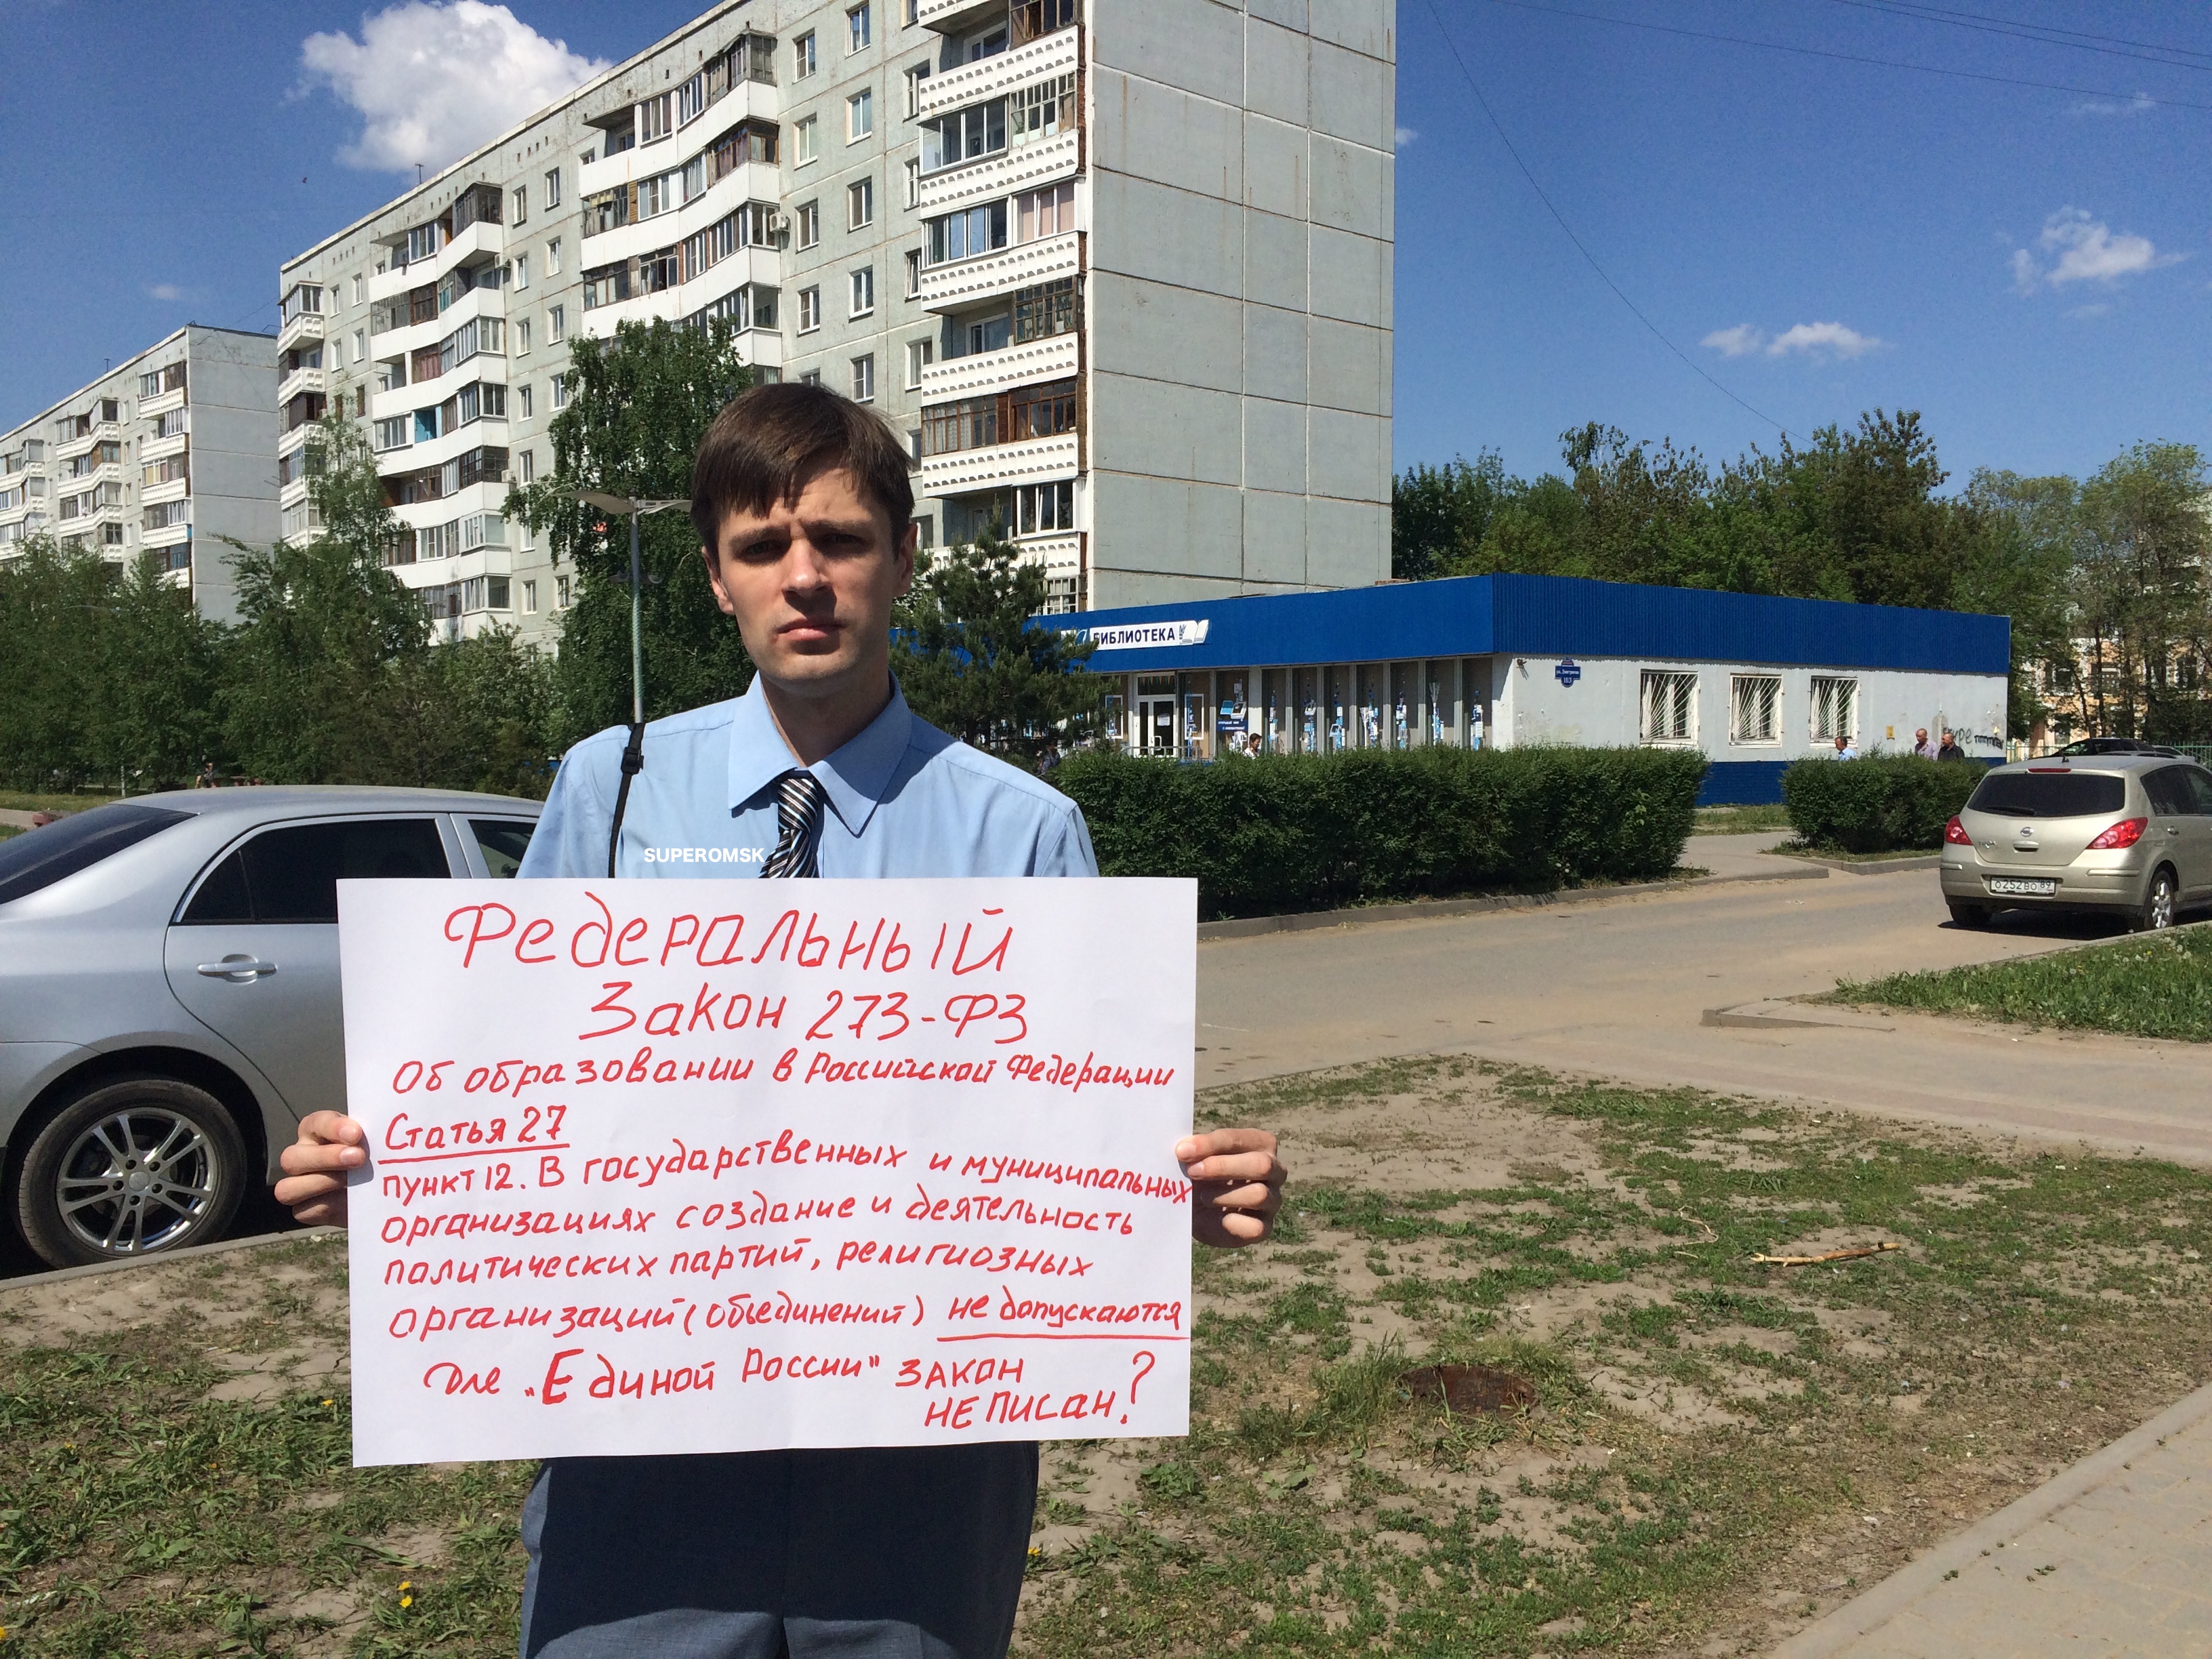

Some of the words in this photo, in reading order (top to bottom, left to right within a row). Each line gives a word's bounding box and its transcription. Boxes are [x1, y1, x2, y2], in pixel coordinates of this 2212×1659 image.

[1093, 628, 1175, 644] БИБЛИОТЕКА
[578, 981, 787, 1041] Закон
[804, 989, 1027, 1045] 273-ФЗ
[392, 1060, 455, 1094] Об
[463, 1046, 754, 1099] образовании
[772, 1047, 799, 1083] в
[804, 1051, 998, 1084] Российской
[1006, 1051, 1175, 1093] Федерации
[384, 1112, 507, 1151] Статья
[517, 1104, 567, 1143] 27
[383, 1168, 476, 1207] пункт
[485, 1162, 527, 1191] 12.
[538, 1155, 565, 1188] В
[583, 1128, 908, 1188] государственных
[928, 1152, 953, 1172] и
[960, 1155, 1192, 1204] муниципальных
[380, 1207, 657, 1247] организациях
[676, 1189, 856, 1231] создание
[871, 1195, 893, 1214] и
[905, 1183, 1133, 1235] деятельность
[384, 1254, 659, 1286] политических
[669, 1237, 821, 1280] партий,
[836, 1240, 1093, 1277] религиозных
[388, 1297, 686, 1343] организаций
[947, 1294, 990, 1320] не
[999, 1285, 1182, 1331] допускаются
[924, 1395, 980, 1430] НЕ
